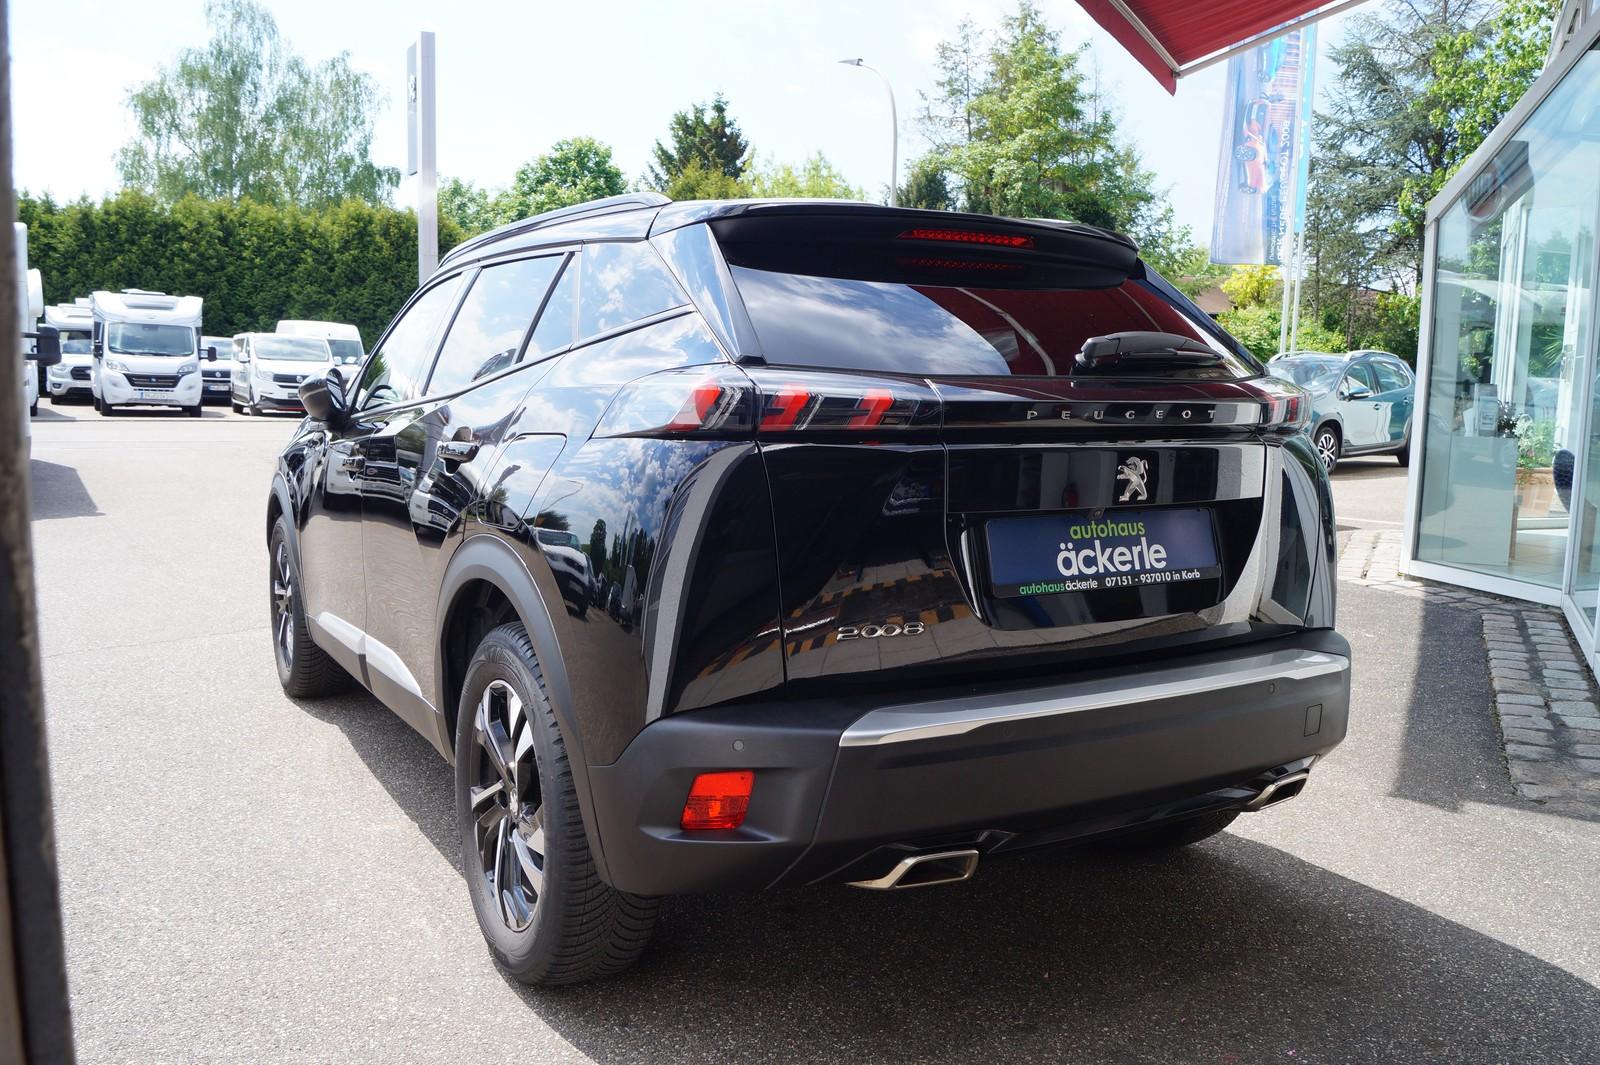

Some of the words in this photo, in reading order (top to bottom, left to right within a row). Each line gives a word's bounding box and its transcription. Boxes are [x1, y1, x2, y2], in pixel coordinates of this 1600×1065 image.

[1026, 409, 1217, 420] PEUGEOT
[1070, 519, 1146, 540] autohaus
[1056, 536, 1167, 577] äckerle
[1104, 575, 1132, 587] 07151
[1140, 570, 1172, 583] 937010
[1172, 570, 1181, 581] in
[1182, 568, 1201, 580] Korb
[836, 621, 925, 641] 2008
